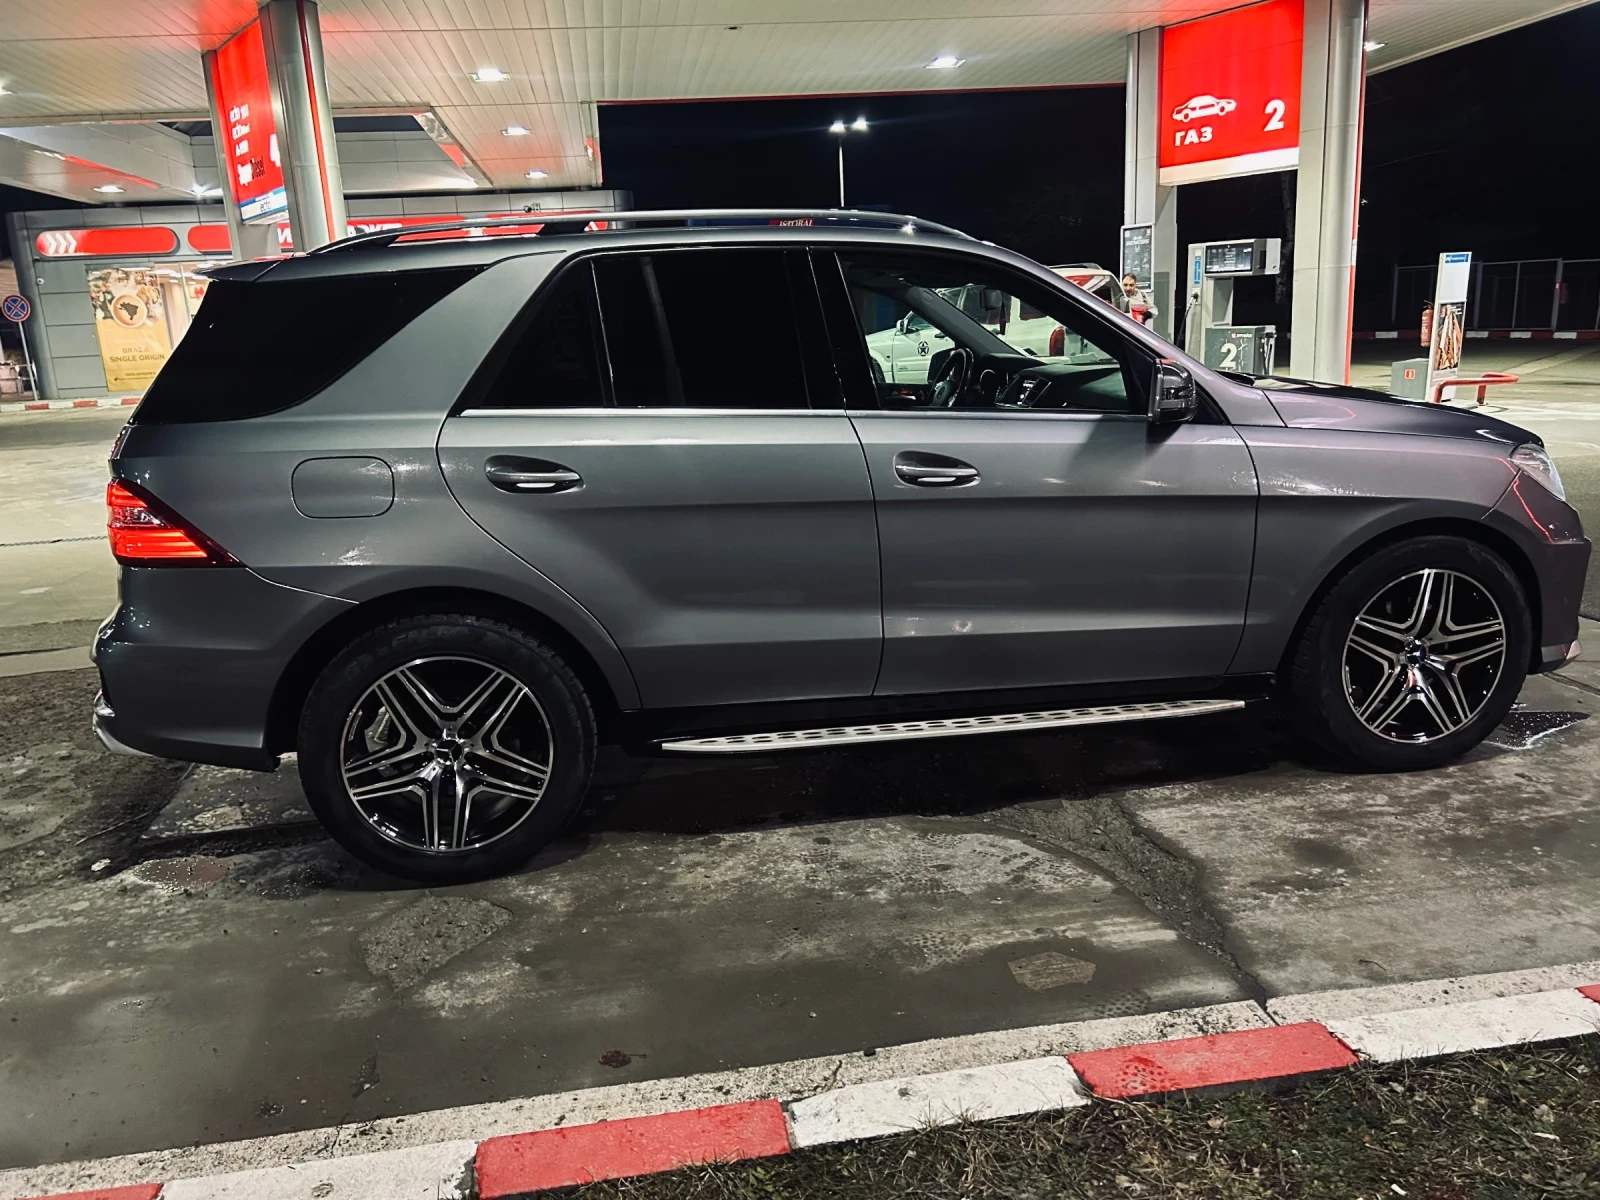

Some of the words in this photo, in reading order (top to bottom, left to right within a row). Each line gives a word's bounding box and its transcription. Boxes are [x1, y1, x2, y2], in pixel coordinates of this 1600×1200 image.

[1263, 99, 1286, 132] 2
[1174, 126, 1213, 147] ГАЗ
[1219, 342, 1238, 368] 2
